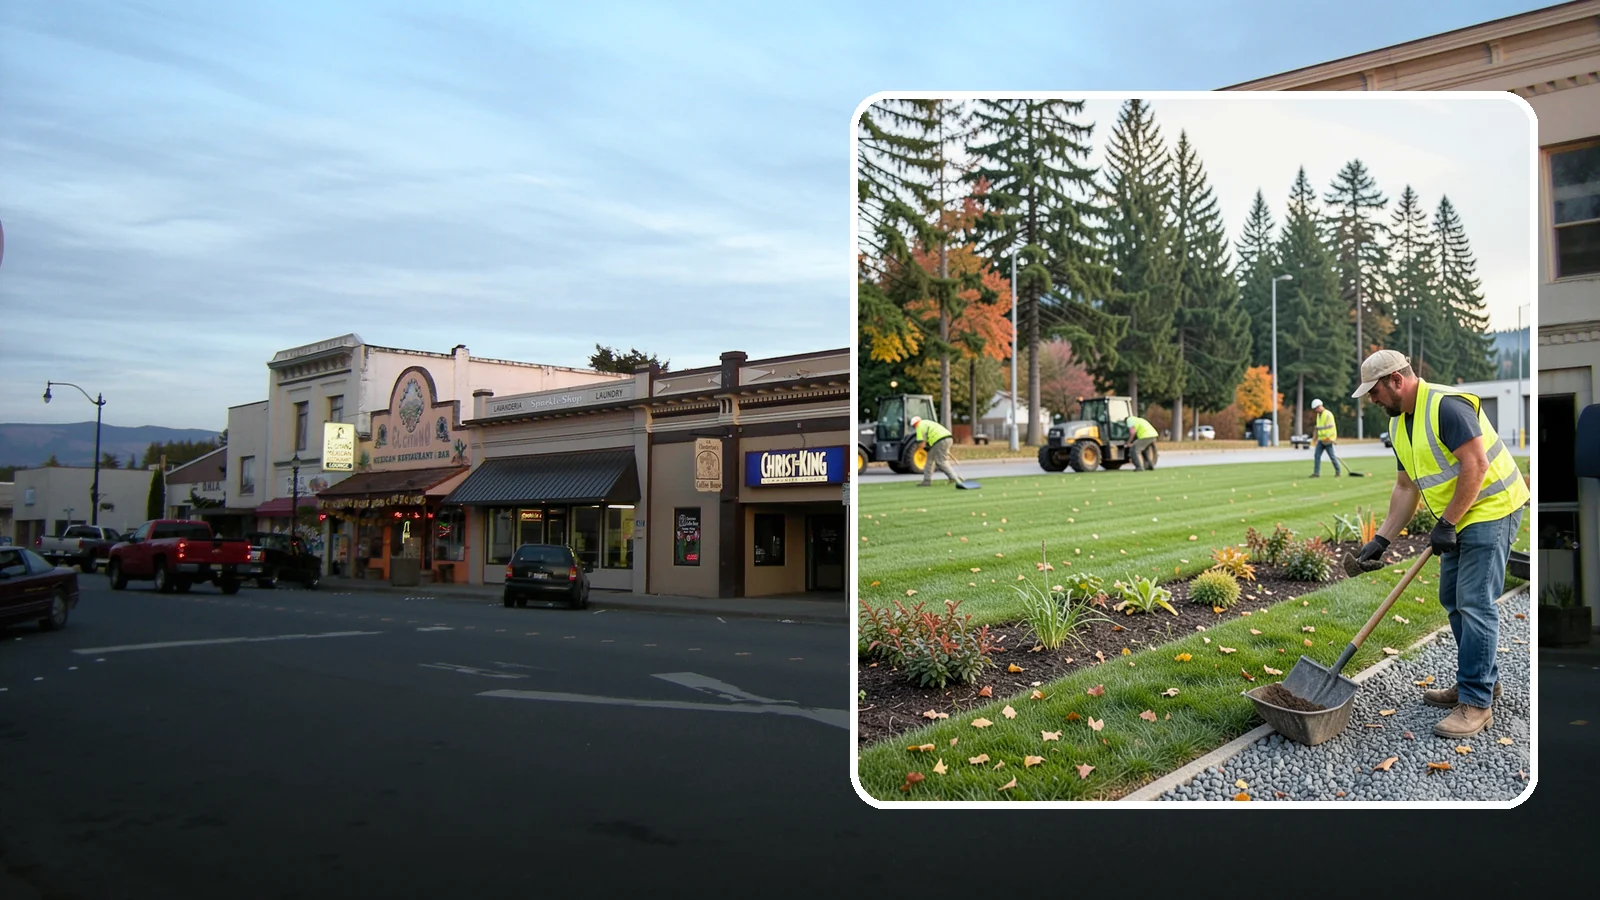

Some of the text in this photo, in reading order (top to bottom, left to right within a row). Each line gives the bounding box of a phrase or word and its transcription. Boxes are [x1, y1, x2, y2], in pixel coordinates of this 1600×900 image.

[530, 394, 582, 409] Sparkle Shop
[595, 389, 623, 400] LAUNDRY
[493, 402, 523, 412] LAVANDERIA
[374, 455, 396, 464] MEXICAN
[397, 451, 433, 462] RESTAURANT
[437, 450, 450, 459] BAR
[760, 450, 828, 478] CHRIST KING
